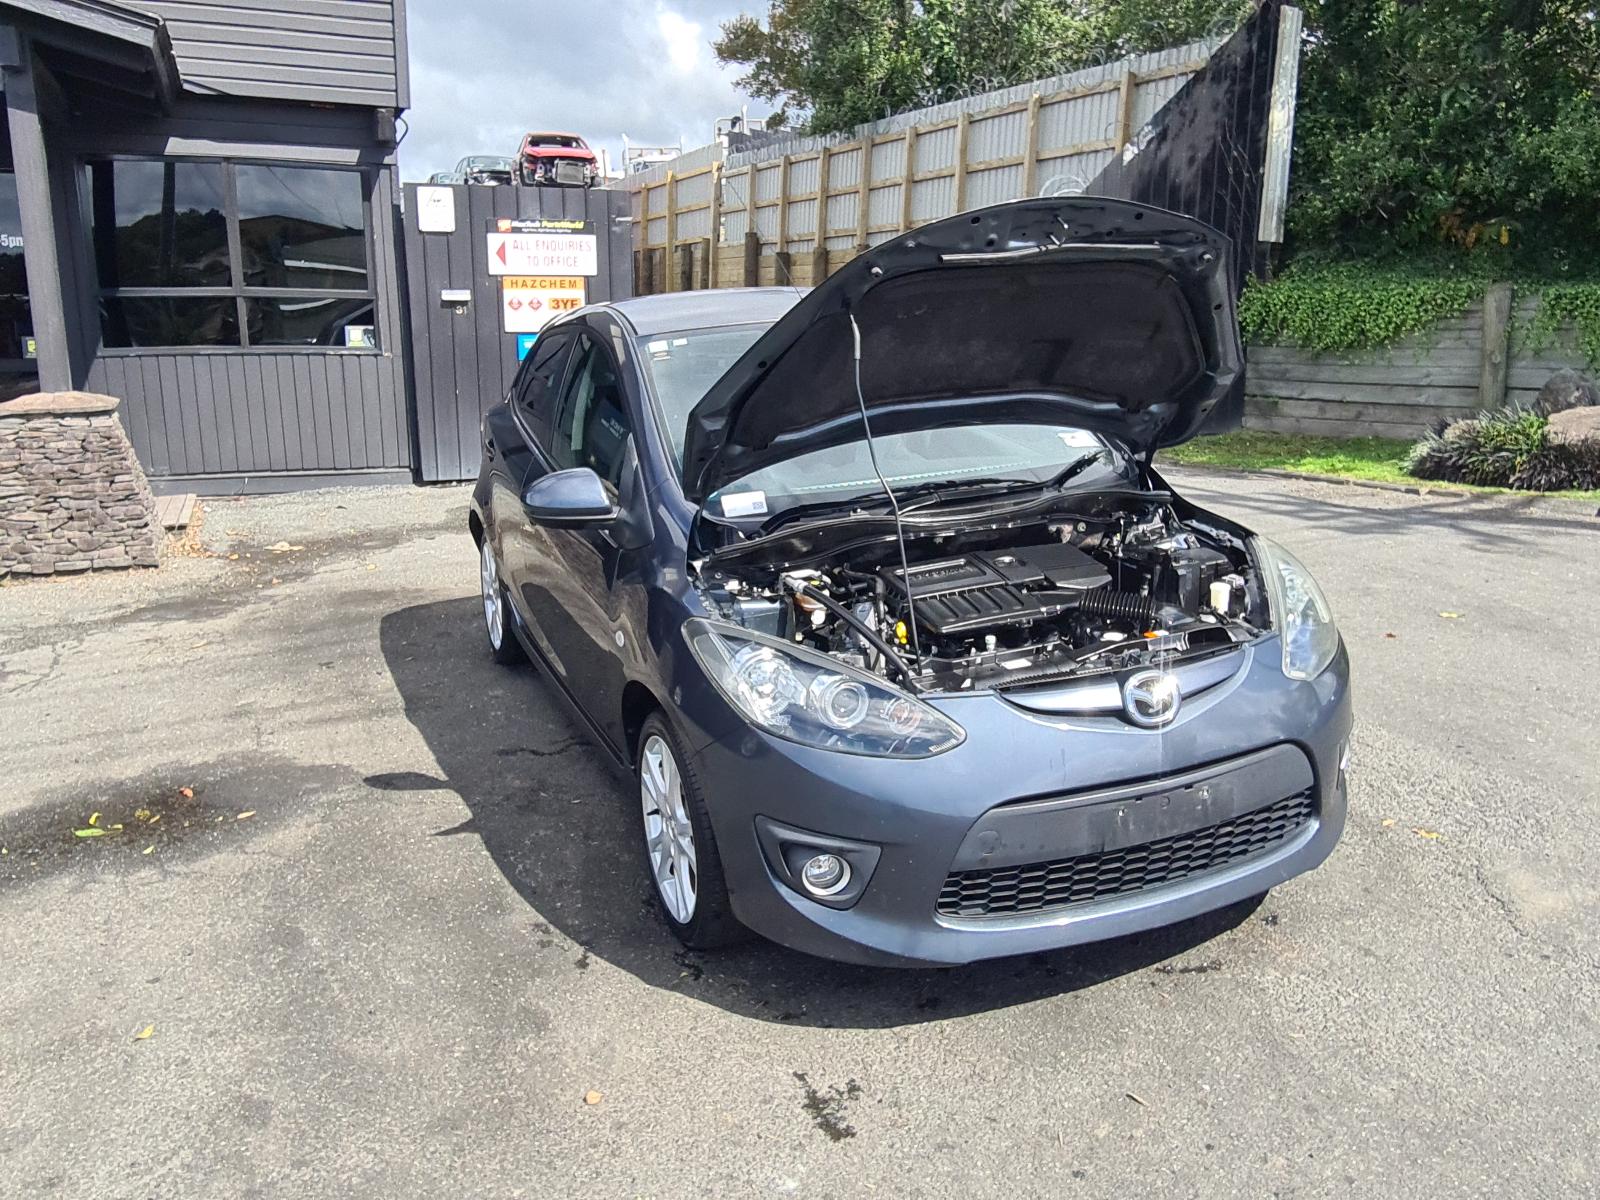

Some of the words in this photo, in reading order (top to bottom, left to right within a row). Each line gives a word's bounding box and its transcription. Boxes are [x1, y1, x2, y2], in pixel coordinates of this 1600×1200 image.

[512, 239, 531, 251] ALL
[535, 239, 592, 252] ENQUIRIES
[527, 255, 539, 267] TO
[543, 255, 580, 268] OFFICE
[510, 279, 577, 289] HAZCHEM
